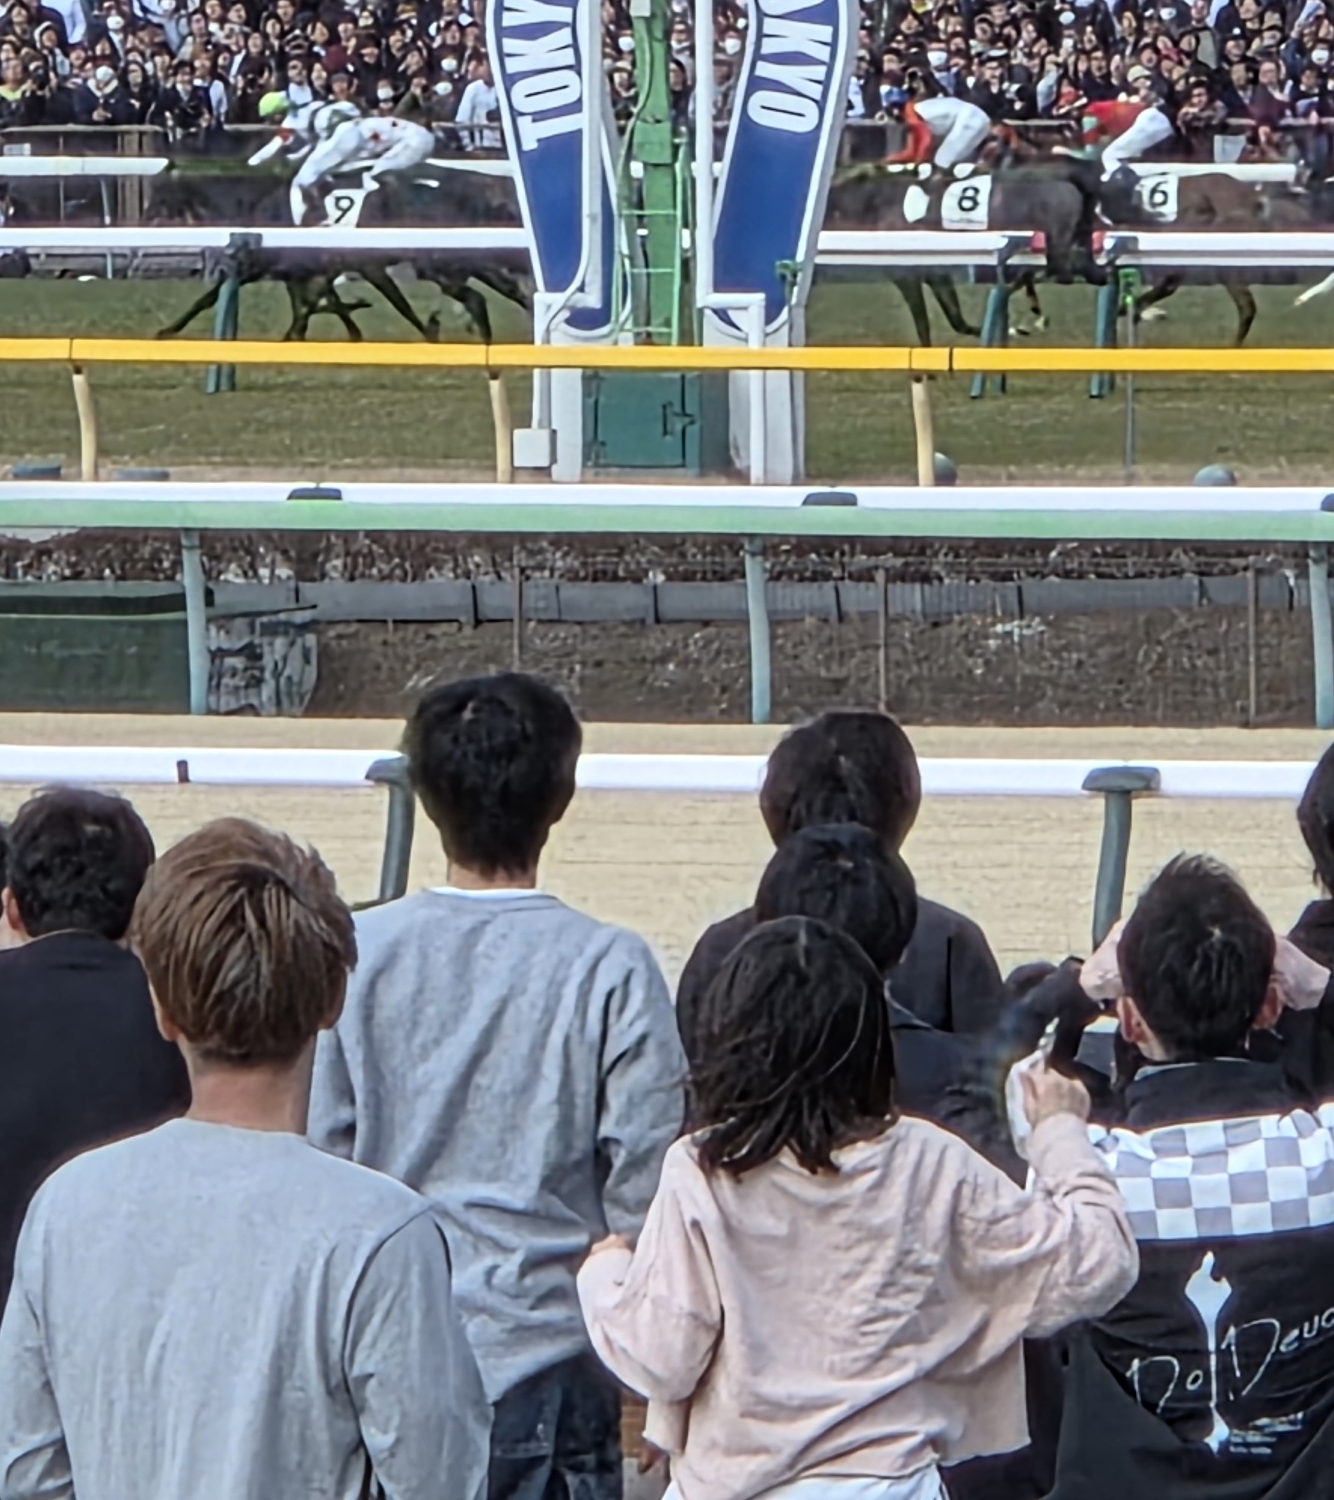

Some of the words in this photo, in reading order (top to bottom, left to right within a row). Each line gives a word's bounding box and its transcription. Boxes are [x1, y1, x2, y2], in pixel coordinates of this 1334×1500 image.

[957, 185, 980, 213] 8
[1148, 180, 1169, 208] 6
[333, 195, 355, 224] 9
